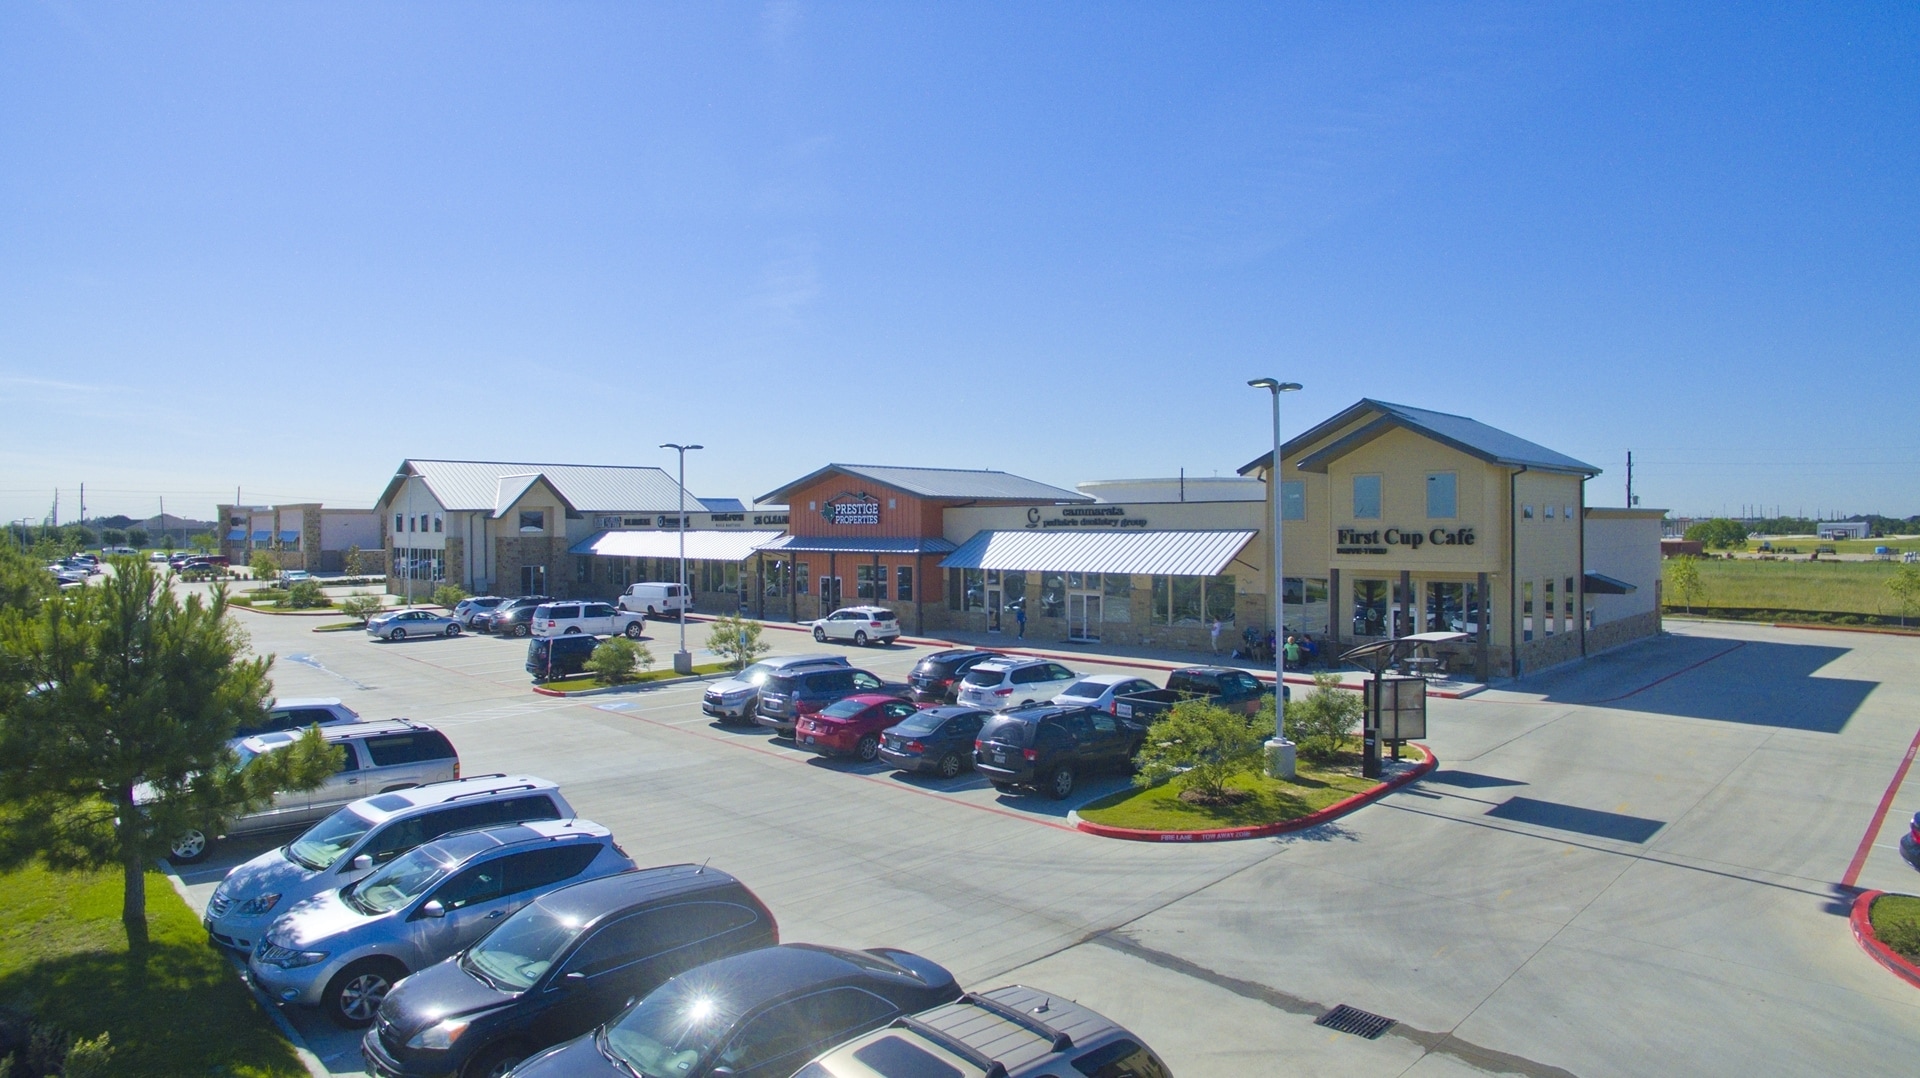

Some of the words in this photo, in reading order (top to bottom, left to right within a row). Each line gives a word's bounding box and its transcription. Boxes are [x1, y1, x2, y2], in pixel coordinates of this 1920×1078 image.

[835, 503, 879, 515] PRESTIGE
[1062, 506, 1125, 516] cammarata
[835, 515, 879, 524] PROPERTIES
[1120, 519, 1148, 528] group
[1337, 528, 1380, 545] First
[1384, 528, 1424, 550] Cup
[1429, 528, 1475, 546] Café
[1202, 833, 1217, 841] TOW
[1217, 832, 1234, 840] AWAY
